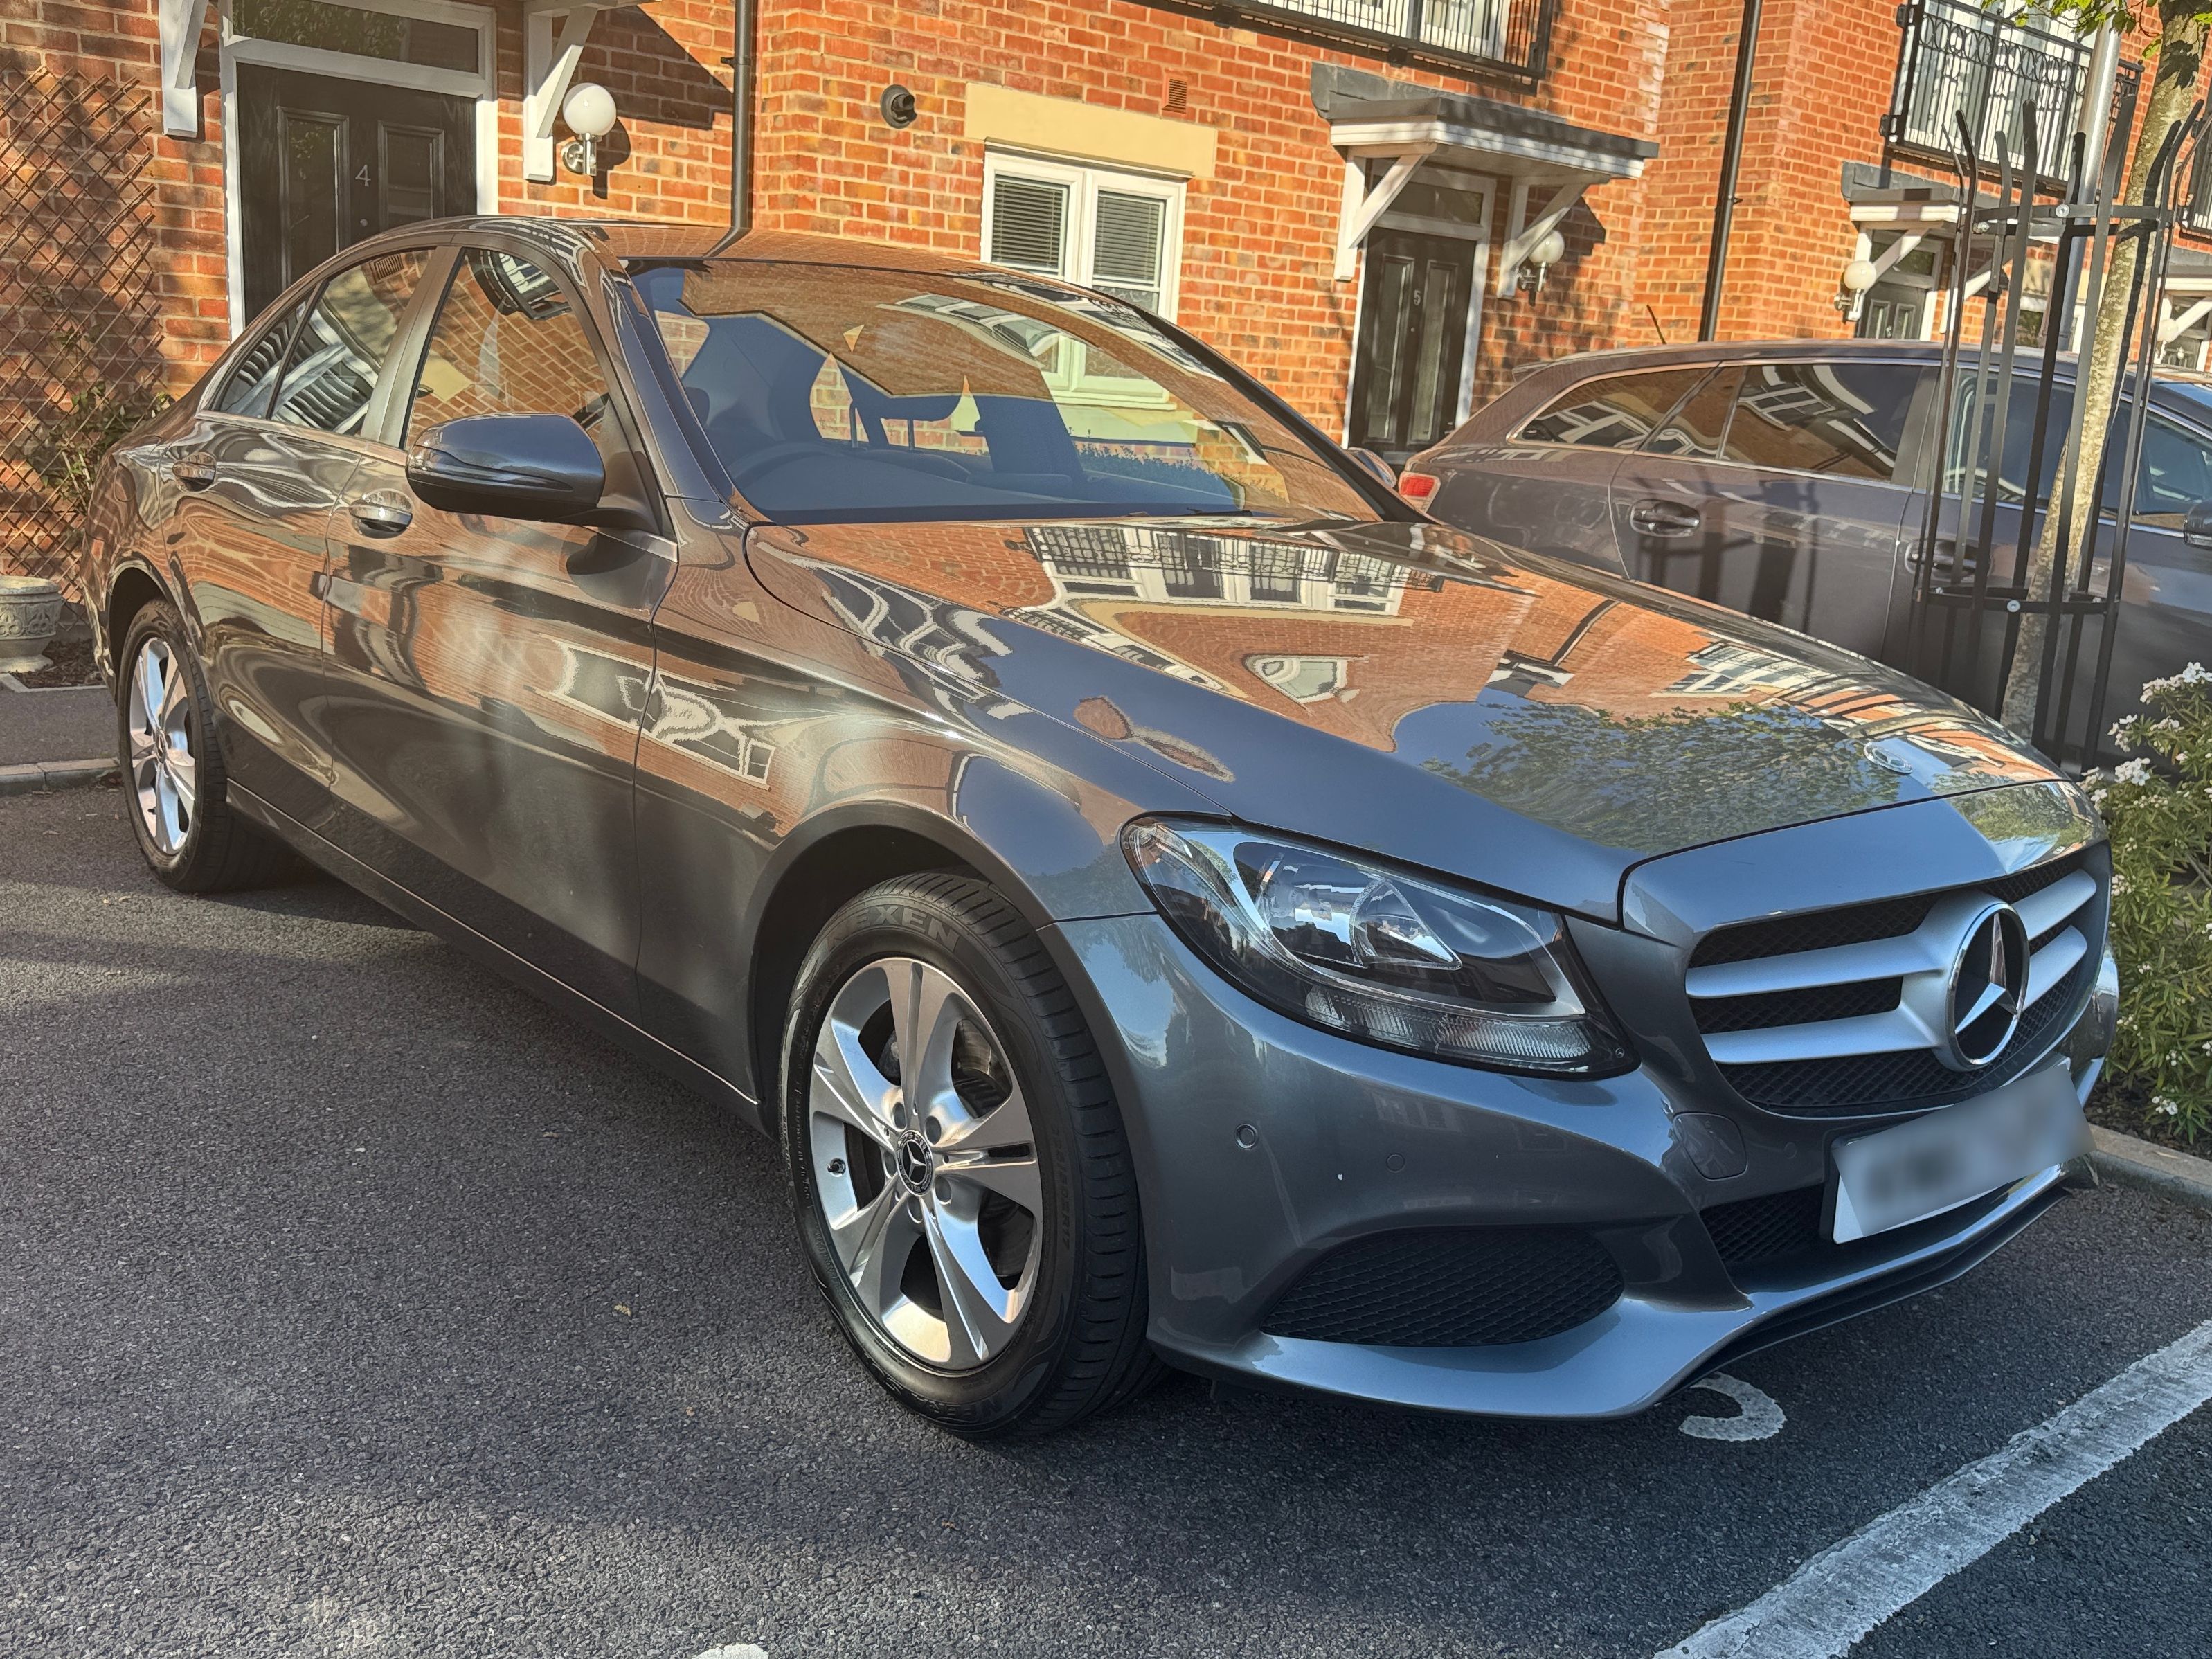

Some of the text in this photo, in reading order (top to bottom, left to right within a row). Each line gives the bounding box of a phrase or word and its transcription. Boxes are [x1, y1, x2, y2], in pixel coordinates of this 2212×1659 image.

[355, 164, 371, 187] 4
[1414, 290, 1421, 305] 5
[826, 905, 960, 953] NEXEN
